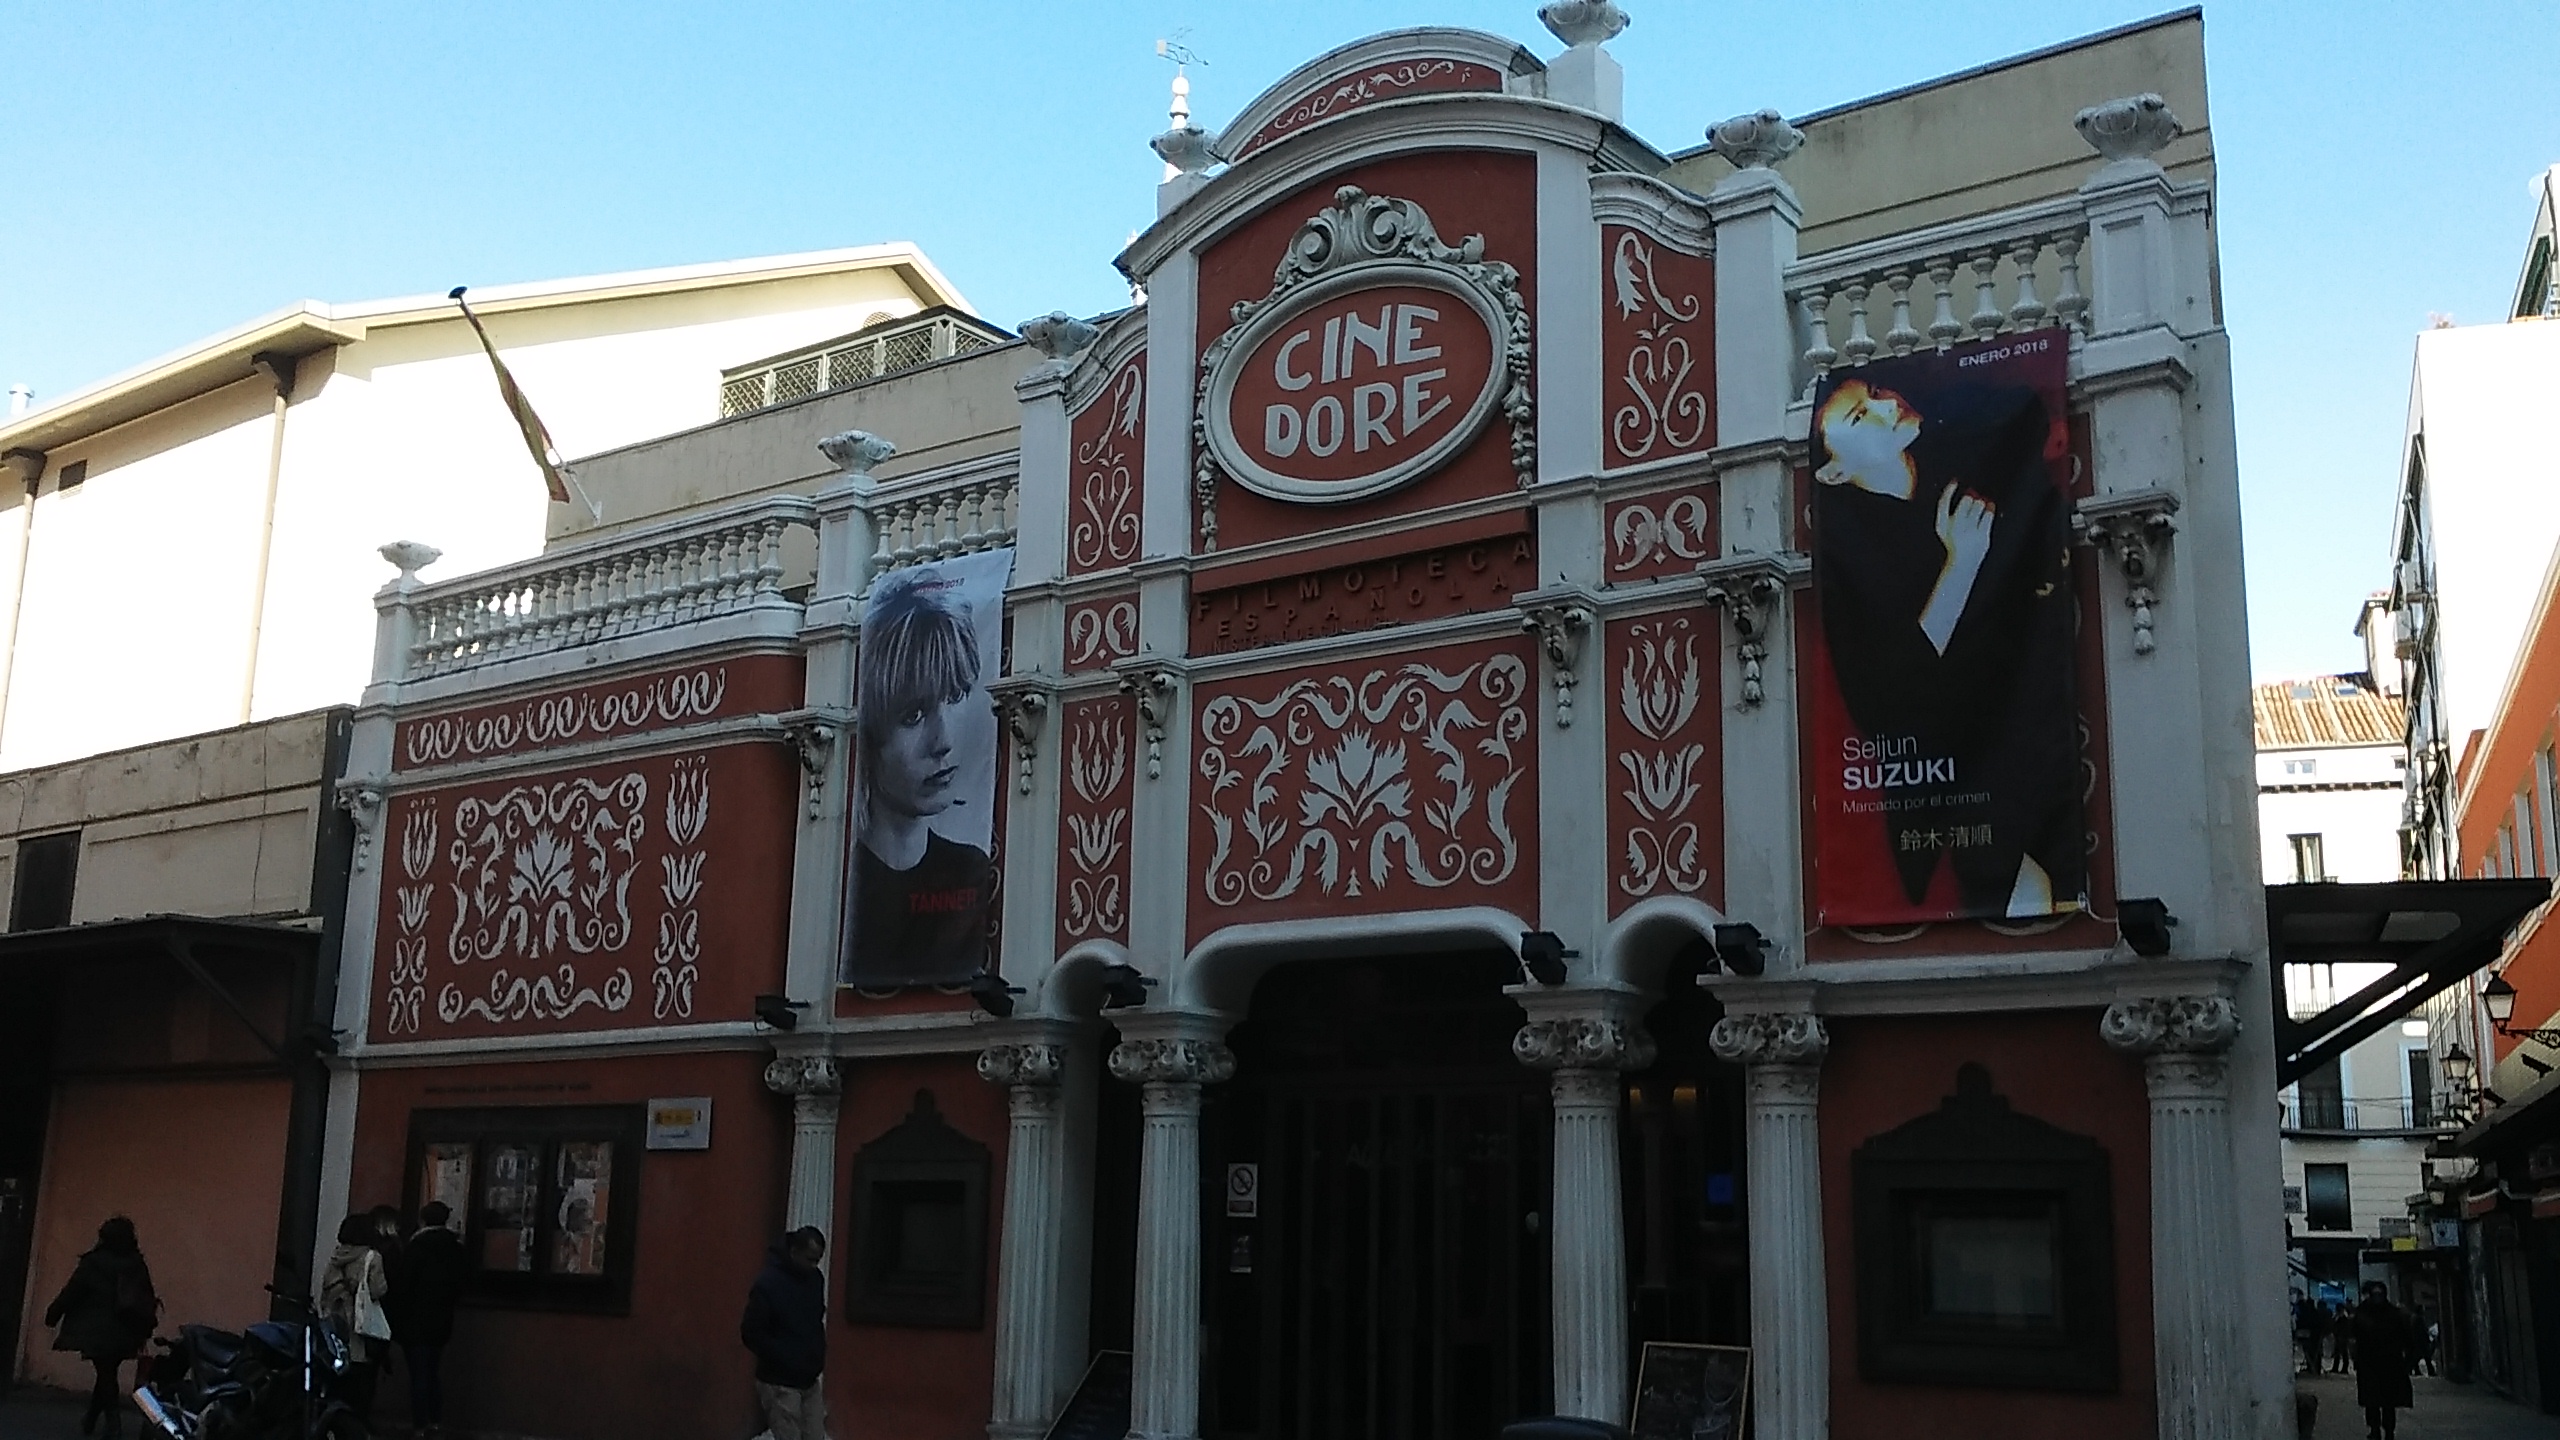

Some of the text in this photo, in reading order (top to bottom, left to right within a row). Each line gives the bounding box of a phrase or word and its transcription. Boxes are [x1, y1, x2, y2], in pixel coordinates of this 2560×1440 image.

[1274, 304, 1442, 391] CINE
[1958, 338, 2049, 368] ENERO 2018
[1264, 368, 1453, 458] DORE
[1197, 540, 1530, 620] FILMOTECA
[1217, 573, 1508, 638] ESPAÑOLA
[1842, 733, 1918, 763] Seijun
[1842, 756, 1957, 791] SUZUKI
[1842, 791, 1991, 814] Marcado por el crimen
[1899, 823, 1993, 852] 鈴木 清順
[910, 887, 976, 913] TANNER
